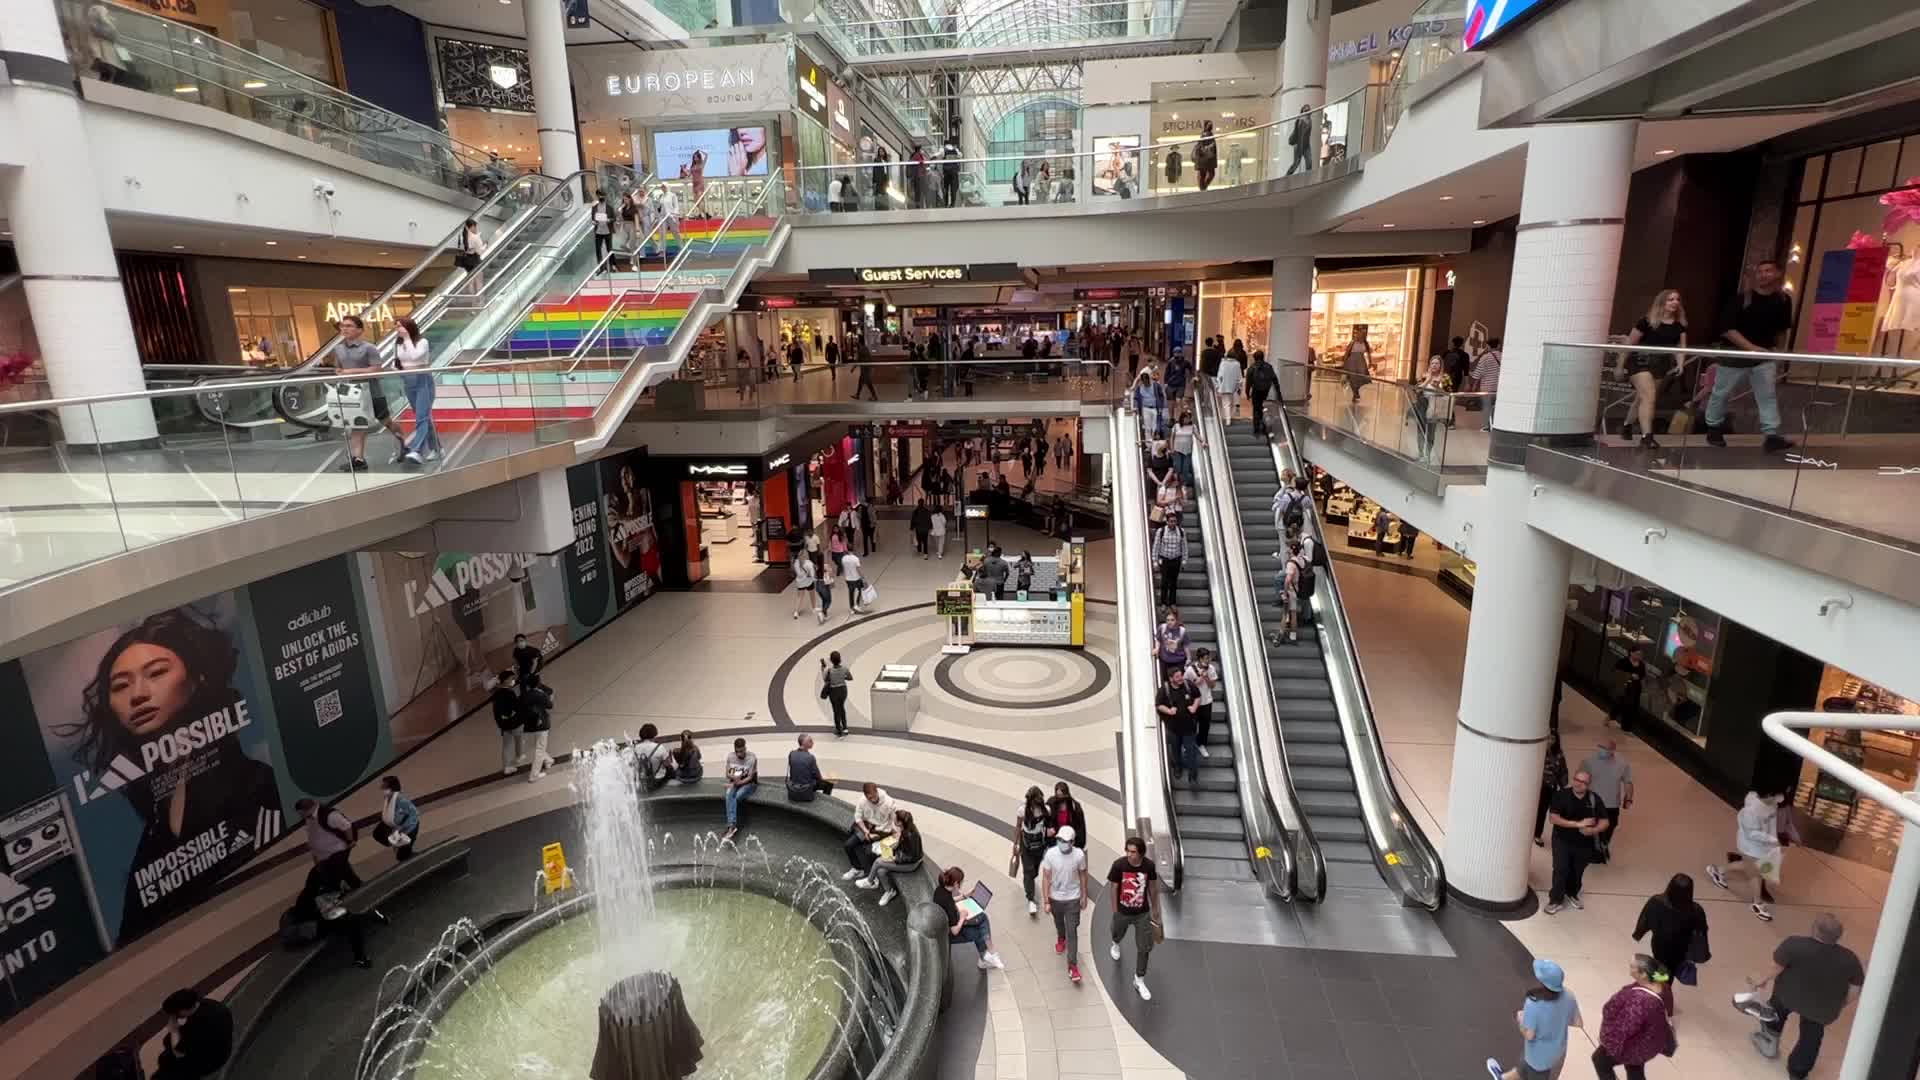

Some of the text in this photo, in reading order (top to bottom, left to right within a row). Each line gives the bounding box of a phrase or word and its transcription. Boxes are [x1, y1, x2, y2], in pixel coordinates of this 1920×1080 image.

[606, 68, 754, 96] EUROPEAN
[862, 266, 962, 281] Guest Services
[325, 301, 394, 322] ARITZIA
[290, 397, 299, 410] 2
[688, 464, 748, 475] MAC
[770, 453, 790, 470] MAC
[574, 501, 597, 523] ENING
[575, 535, 595, 557] 2022
[287, 604, 331, 631] adiclub
[281, 620, 348, 659] UNLOCK THE
[274, 657, 303, 681] BEST
[305, 649, 319, 667] OF
[322, 632, 359, 660] ADIDAS
[140, 699, 251, 774] POSSIBLE
[134, 820, 230, 890] IMPOSSIBLE
[138, 885, 159, 908] IS
[158, 842, 228, 897] NOTHING
